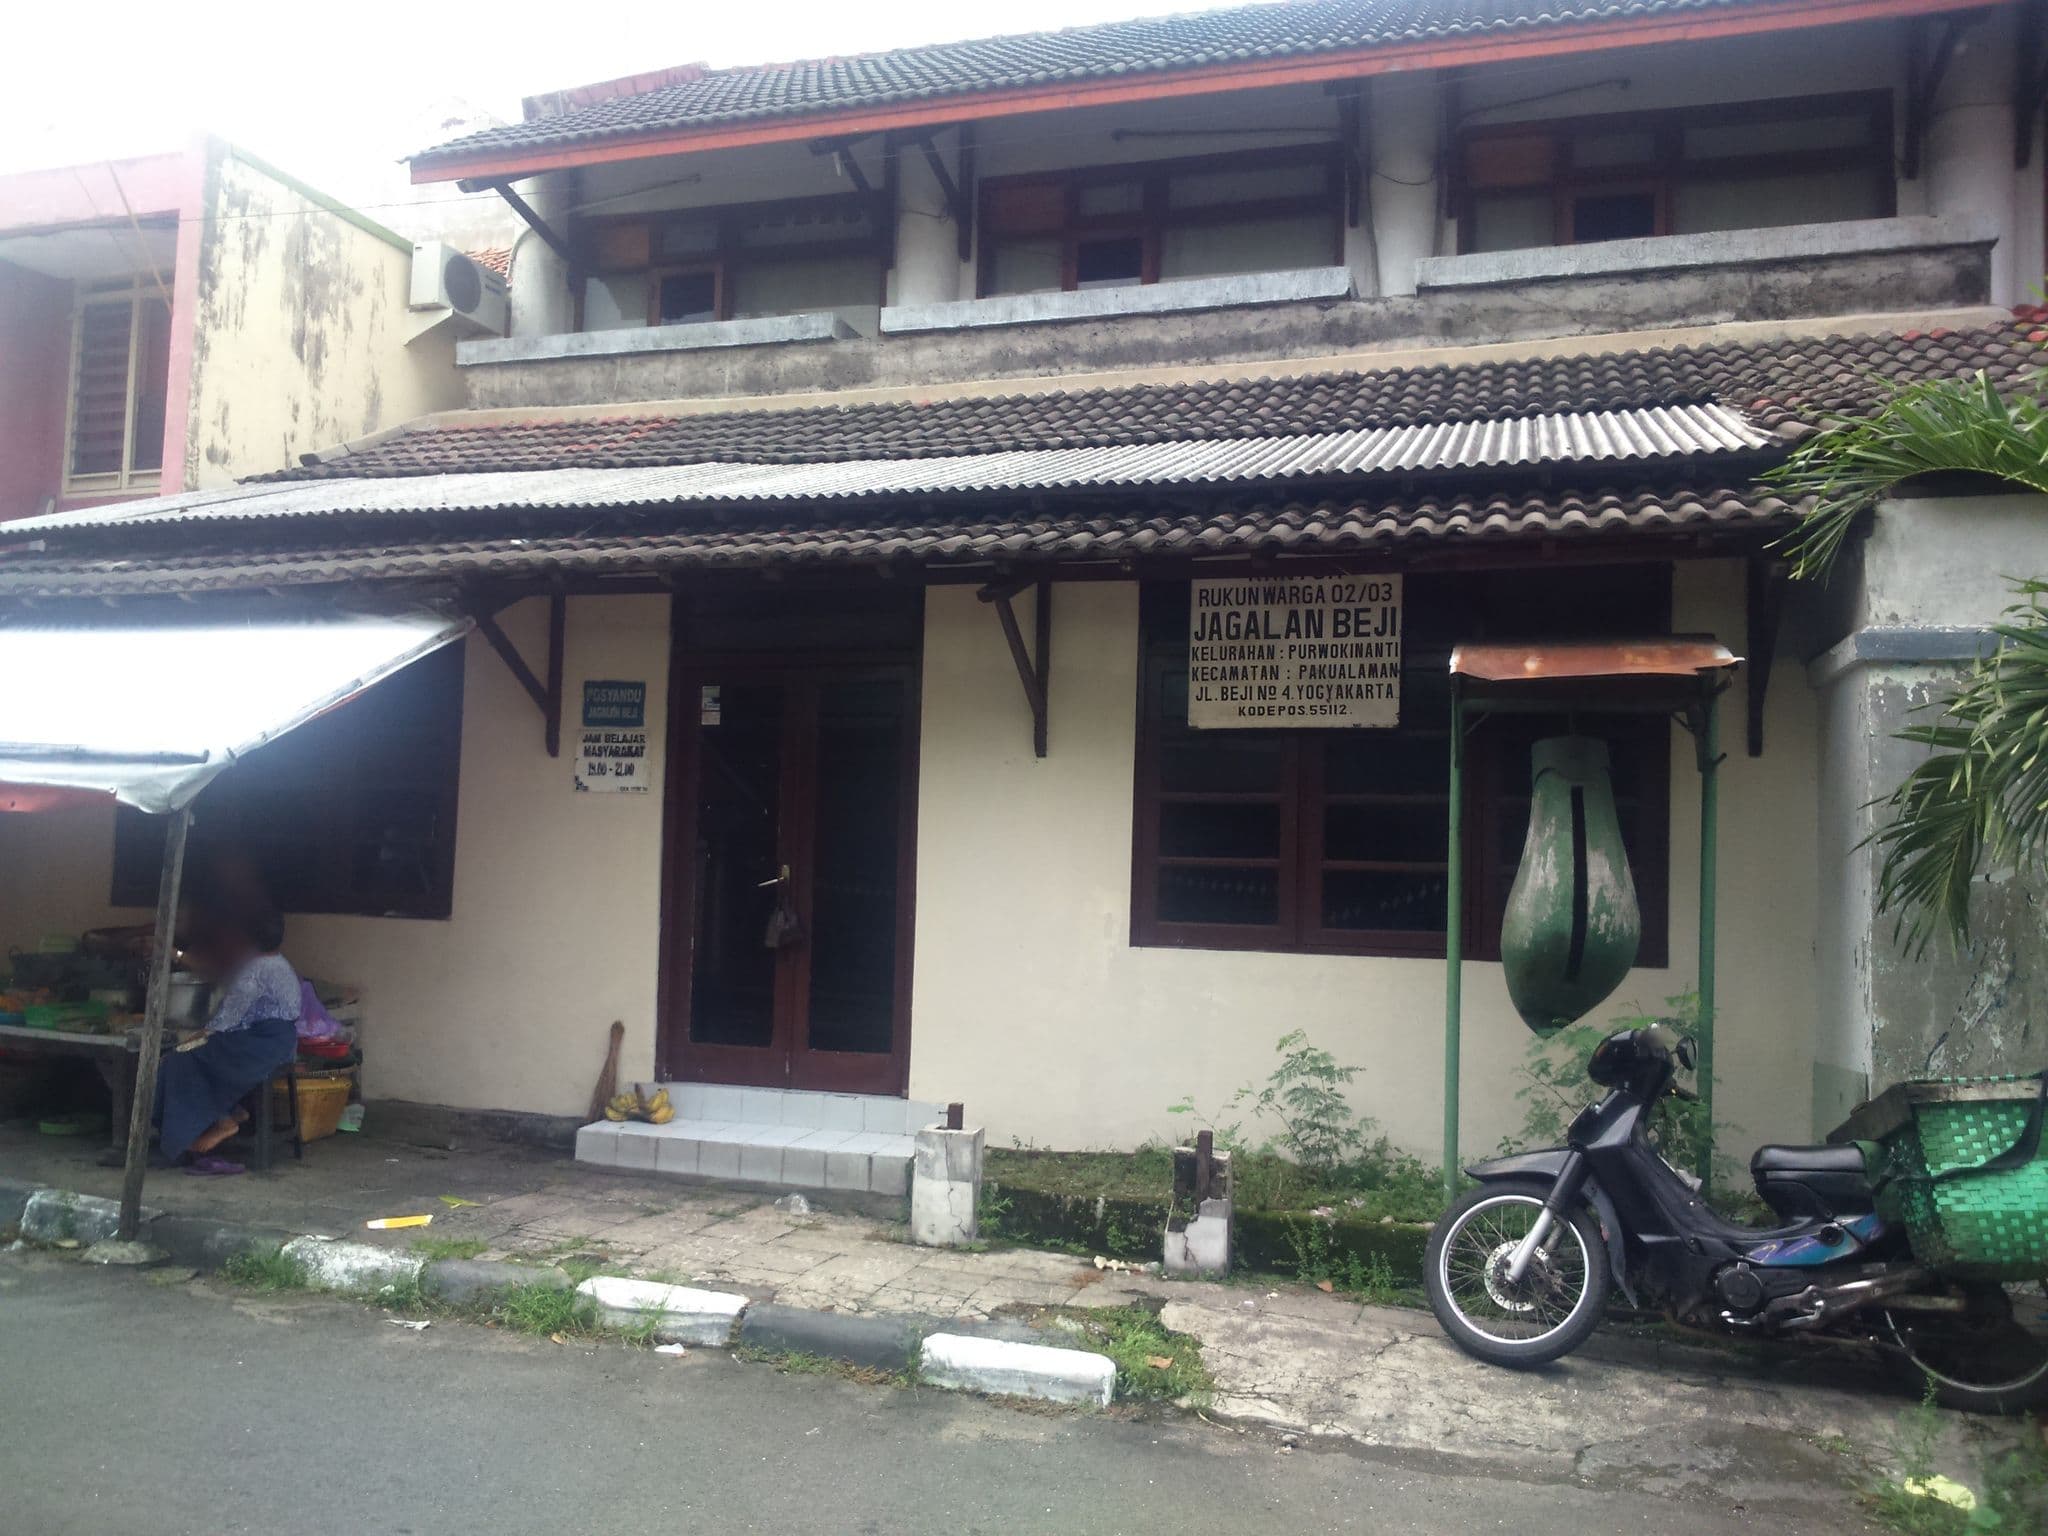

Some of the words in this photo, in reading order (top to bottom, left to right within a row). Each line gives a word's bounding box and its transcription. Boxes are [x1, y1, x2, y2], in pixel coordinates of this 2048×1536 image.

[1199, 586, 1260, 607] RUKUN
[1263, 584, 1326, 605] WARGA
[1331, 582, 1393, 604] 02/03
[1194, 608, 1324, 641] JAGALAN
[1332, 606, 1397, 639] BEJI
[1192, 645, 1275, 662] KELURAHAN
[1288, 642, 1399, 660] PURWOKINANTI
[1192, 665, 1279, 682] KECAMATAN
[1299, 663, 1398, 680] PAKUALAMAN
[1297, 683, 1395, 700] YOGYAKARTA
[583, 734, 602, 744] JAM
[604, 733, 646, 744] BELAJAR
[584, 745, 646, 758] MASYARAKAT
